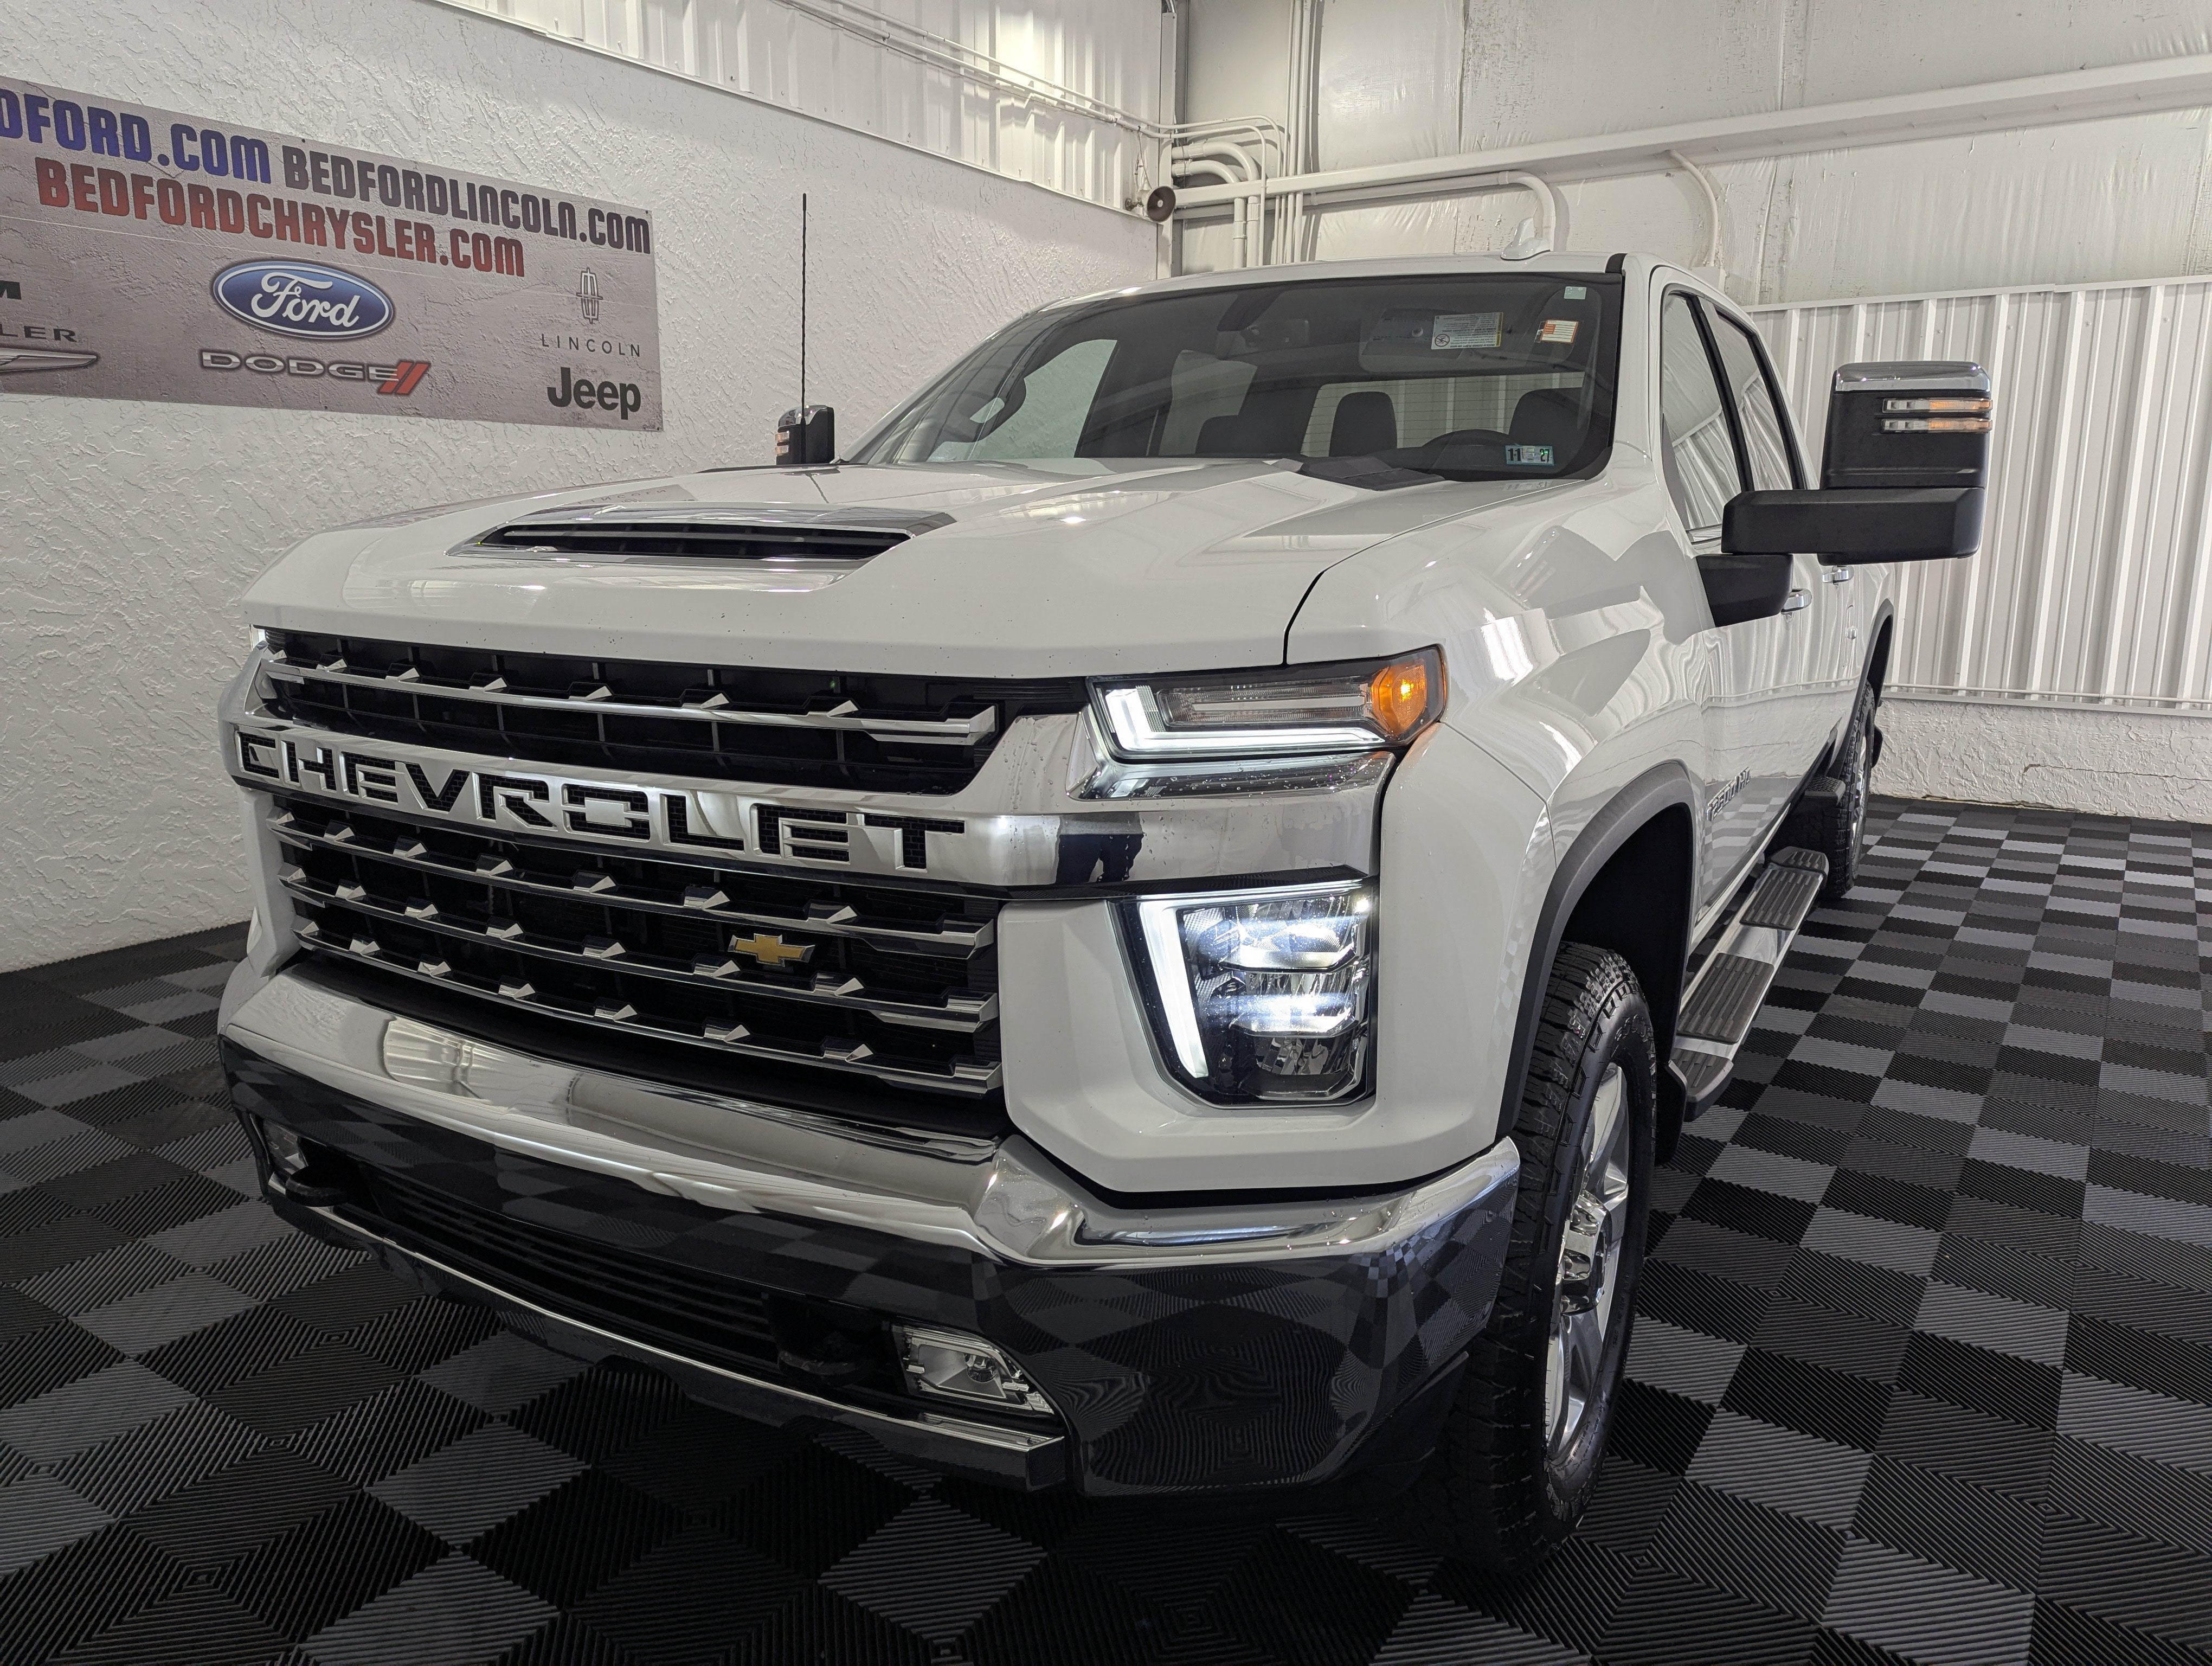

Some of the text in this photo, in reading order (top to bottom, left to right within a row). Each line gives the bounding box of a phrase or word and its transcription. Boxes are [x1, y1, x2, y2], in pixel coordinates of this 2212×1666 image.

[35, 157, 525, 277] BEDFORDCHRYSLER.COM
[282, 145, 651, 254] BEDFORDLINCOLN.COM
[251, 272, 361, 328] Ford
[201, 350, 399, 382] DODGE
[542, 334, 640, 357] LINCOLN
[547, 367, 641, 420] Jeep
[1540, 448, 1550, 463] 27
[235, 731, 965, 872] CHEVROLET
